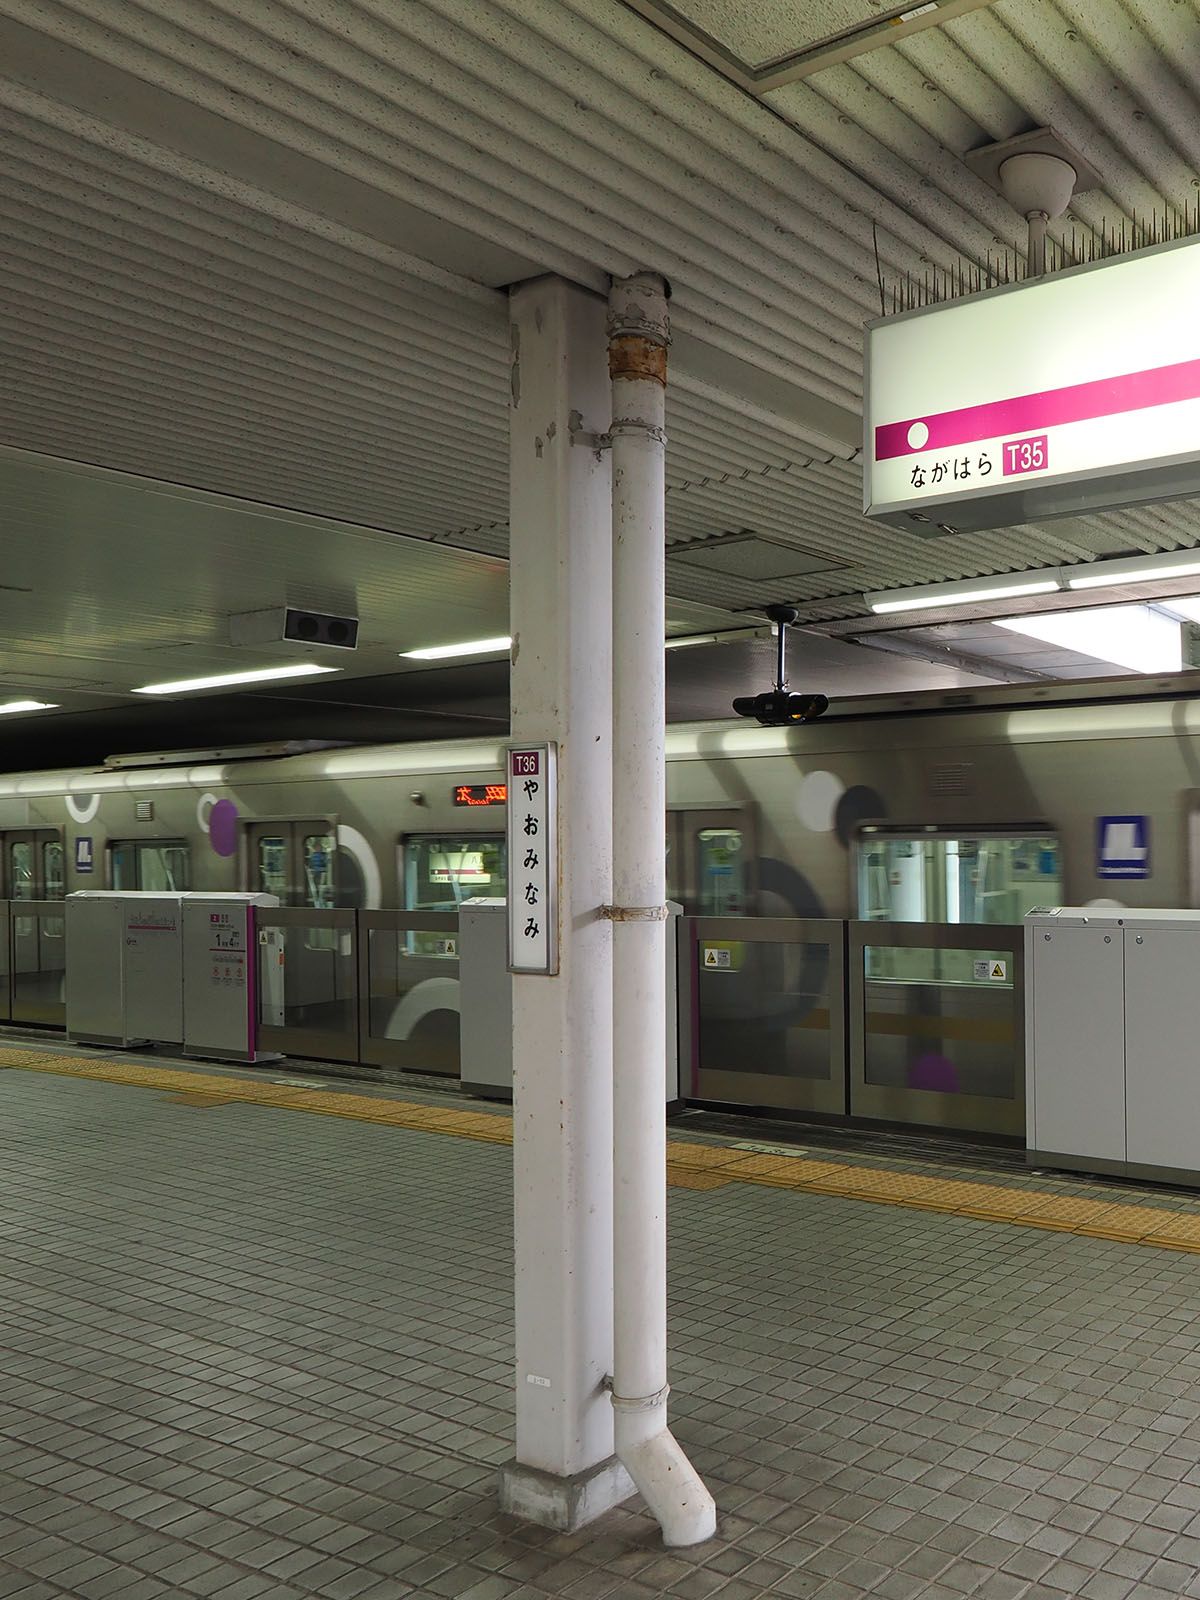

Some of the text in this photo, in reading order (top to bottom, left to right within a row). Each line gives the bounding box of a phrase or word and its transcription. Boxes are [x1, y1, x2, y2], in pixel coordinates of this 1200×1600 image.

[910, 453, 992, 488] ながはら
[1007, 440, 1044, 471] T35
[516, 755, 536, 773] T36
[523, 779, 540, 939] やおみなみ
